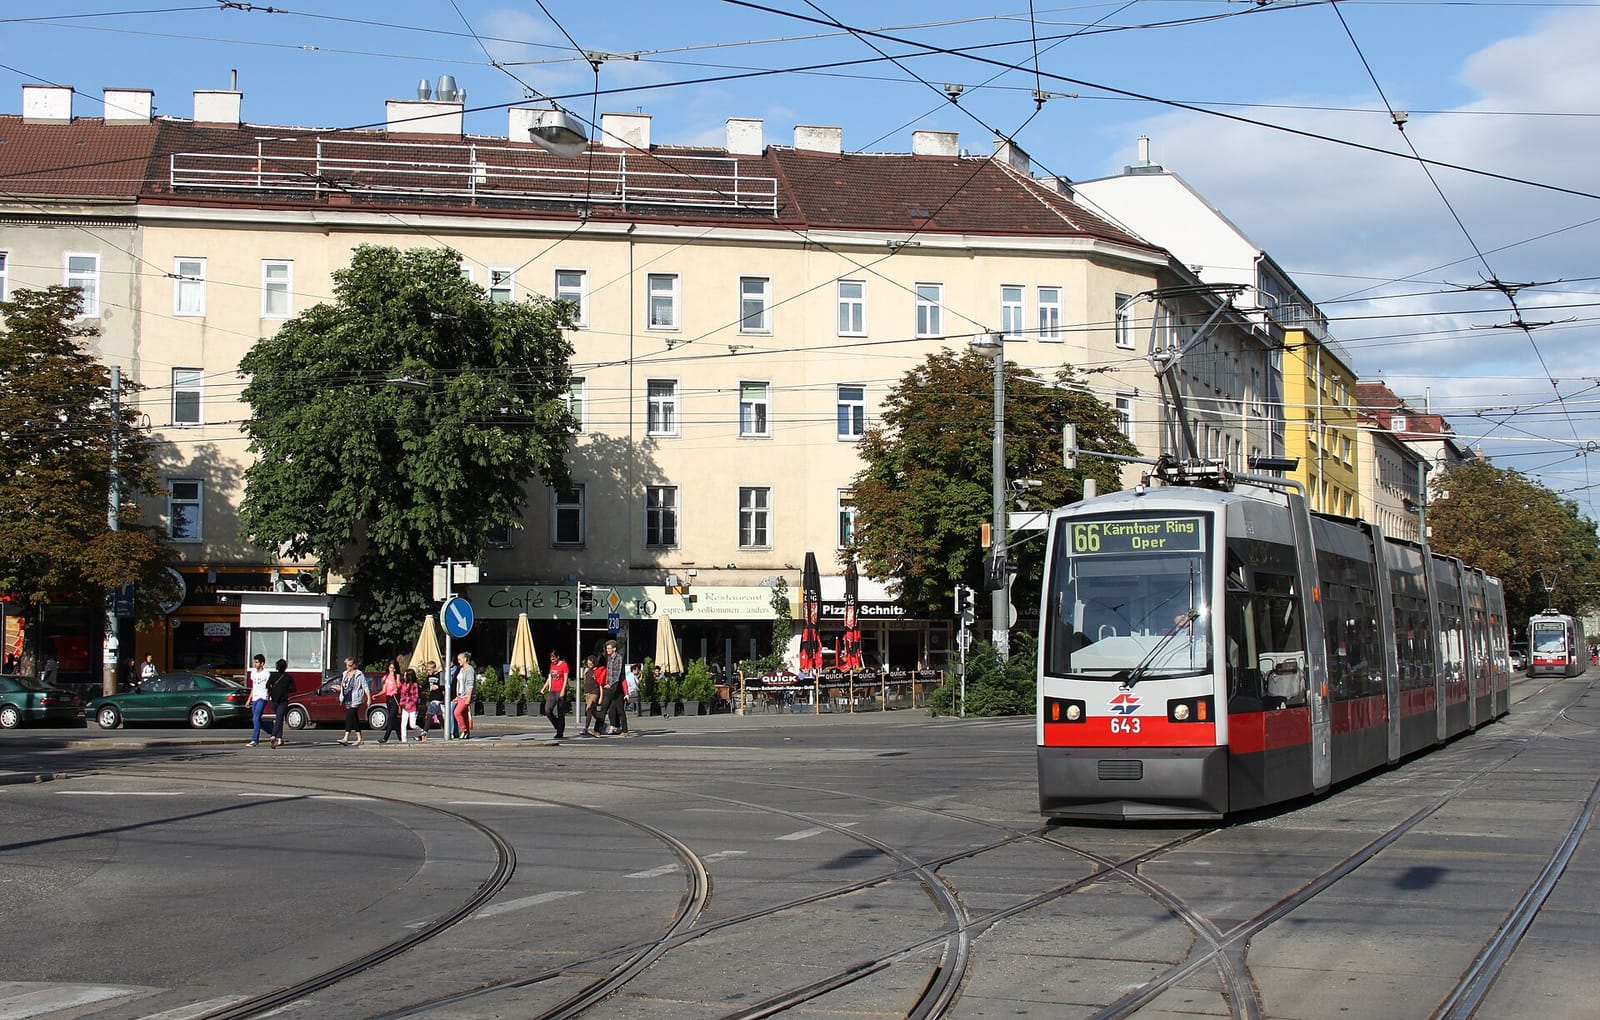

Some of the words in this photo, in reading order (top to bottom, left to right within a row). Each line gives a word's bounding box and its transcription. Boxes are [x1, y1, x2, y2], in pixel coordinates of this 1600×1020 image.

[1103, 523, 1161, 536] Kärntner
[1166, 520, 1194, 534] Ring
[1074, 524, 1101, 552] 66
[1132, 536, 1167, 550] Oper
[194, 585, 275, 593] AMBASSADO
[488, 589, 545, 614] Café
[705, 592, 762, 601] Restaurant
[822, 605, 846, 615] Pizz
[861, 605, 906, 615] Schnitz
[762, 675, 797, 683] QUICK
[1110, 717, 1141, 734] 643
